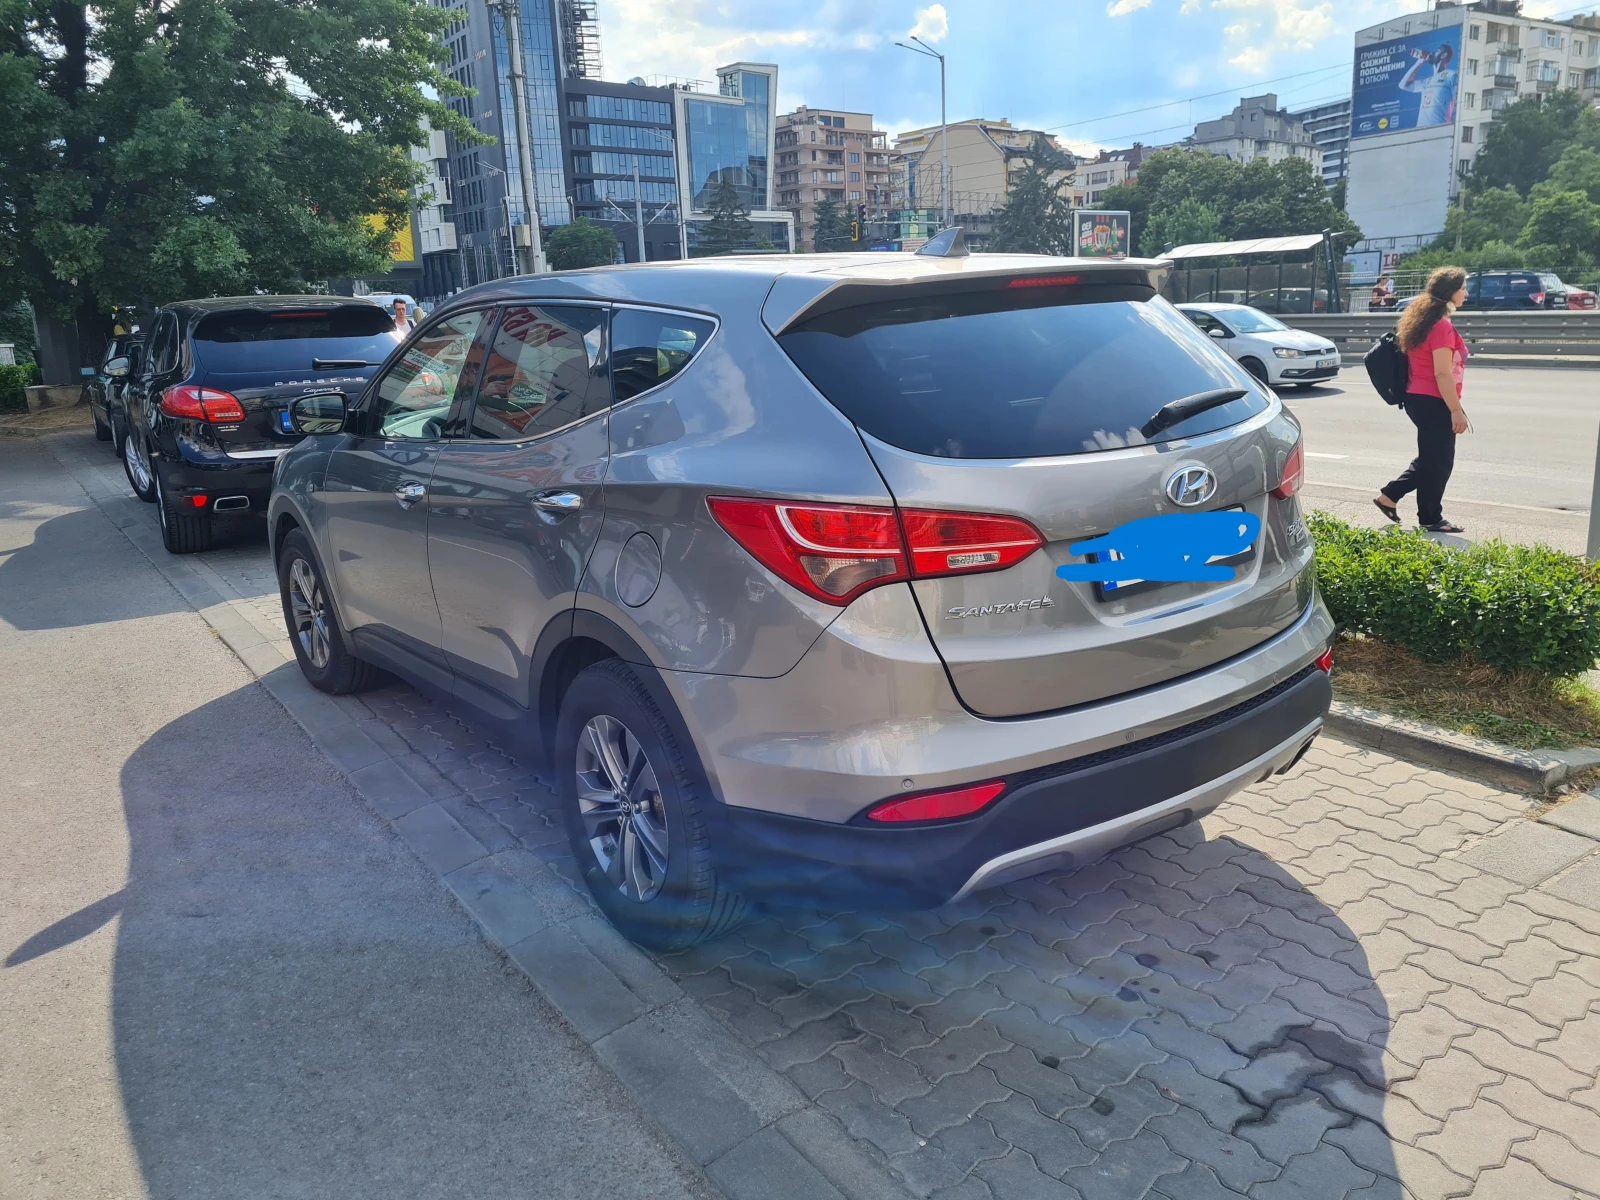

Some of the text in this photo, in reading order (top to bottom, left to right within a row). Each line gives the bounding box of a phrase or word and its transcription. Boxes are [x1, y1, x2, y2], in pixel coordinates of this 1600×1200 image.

[1361, 44, 1406, 60] ГРИЖИМ СЕ ЗА
[1361, 56, 1390, 68] СВЕЖИТЕ
[1360, 61, 1406, 77] ПОПЪЛНЕНИЯ
[1365, 73, 1390, 84] ОТБОРА
[275, 377, 364, 387] PORSCHE
